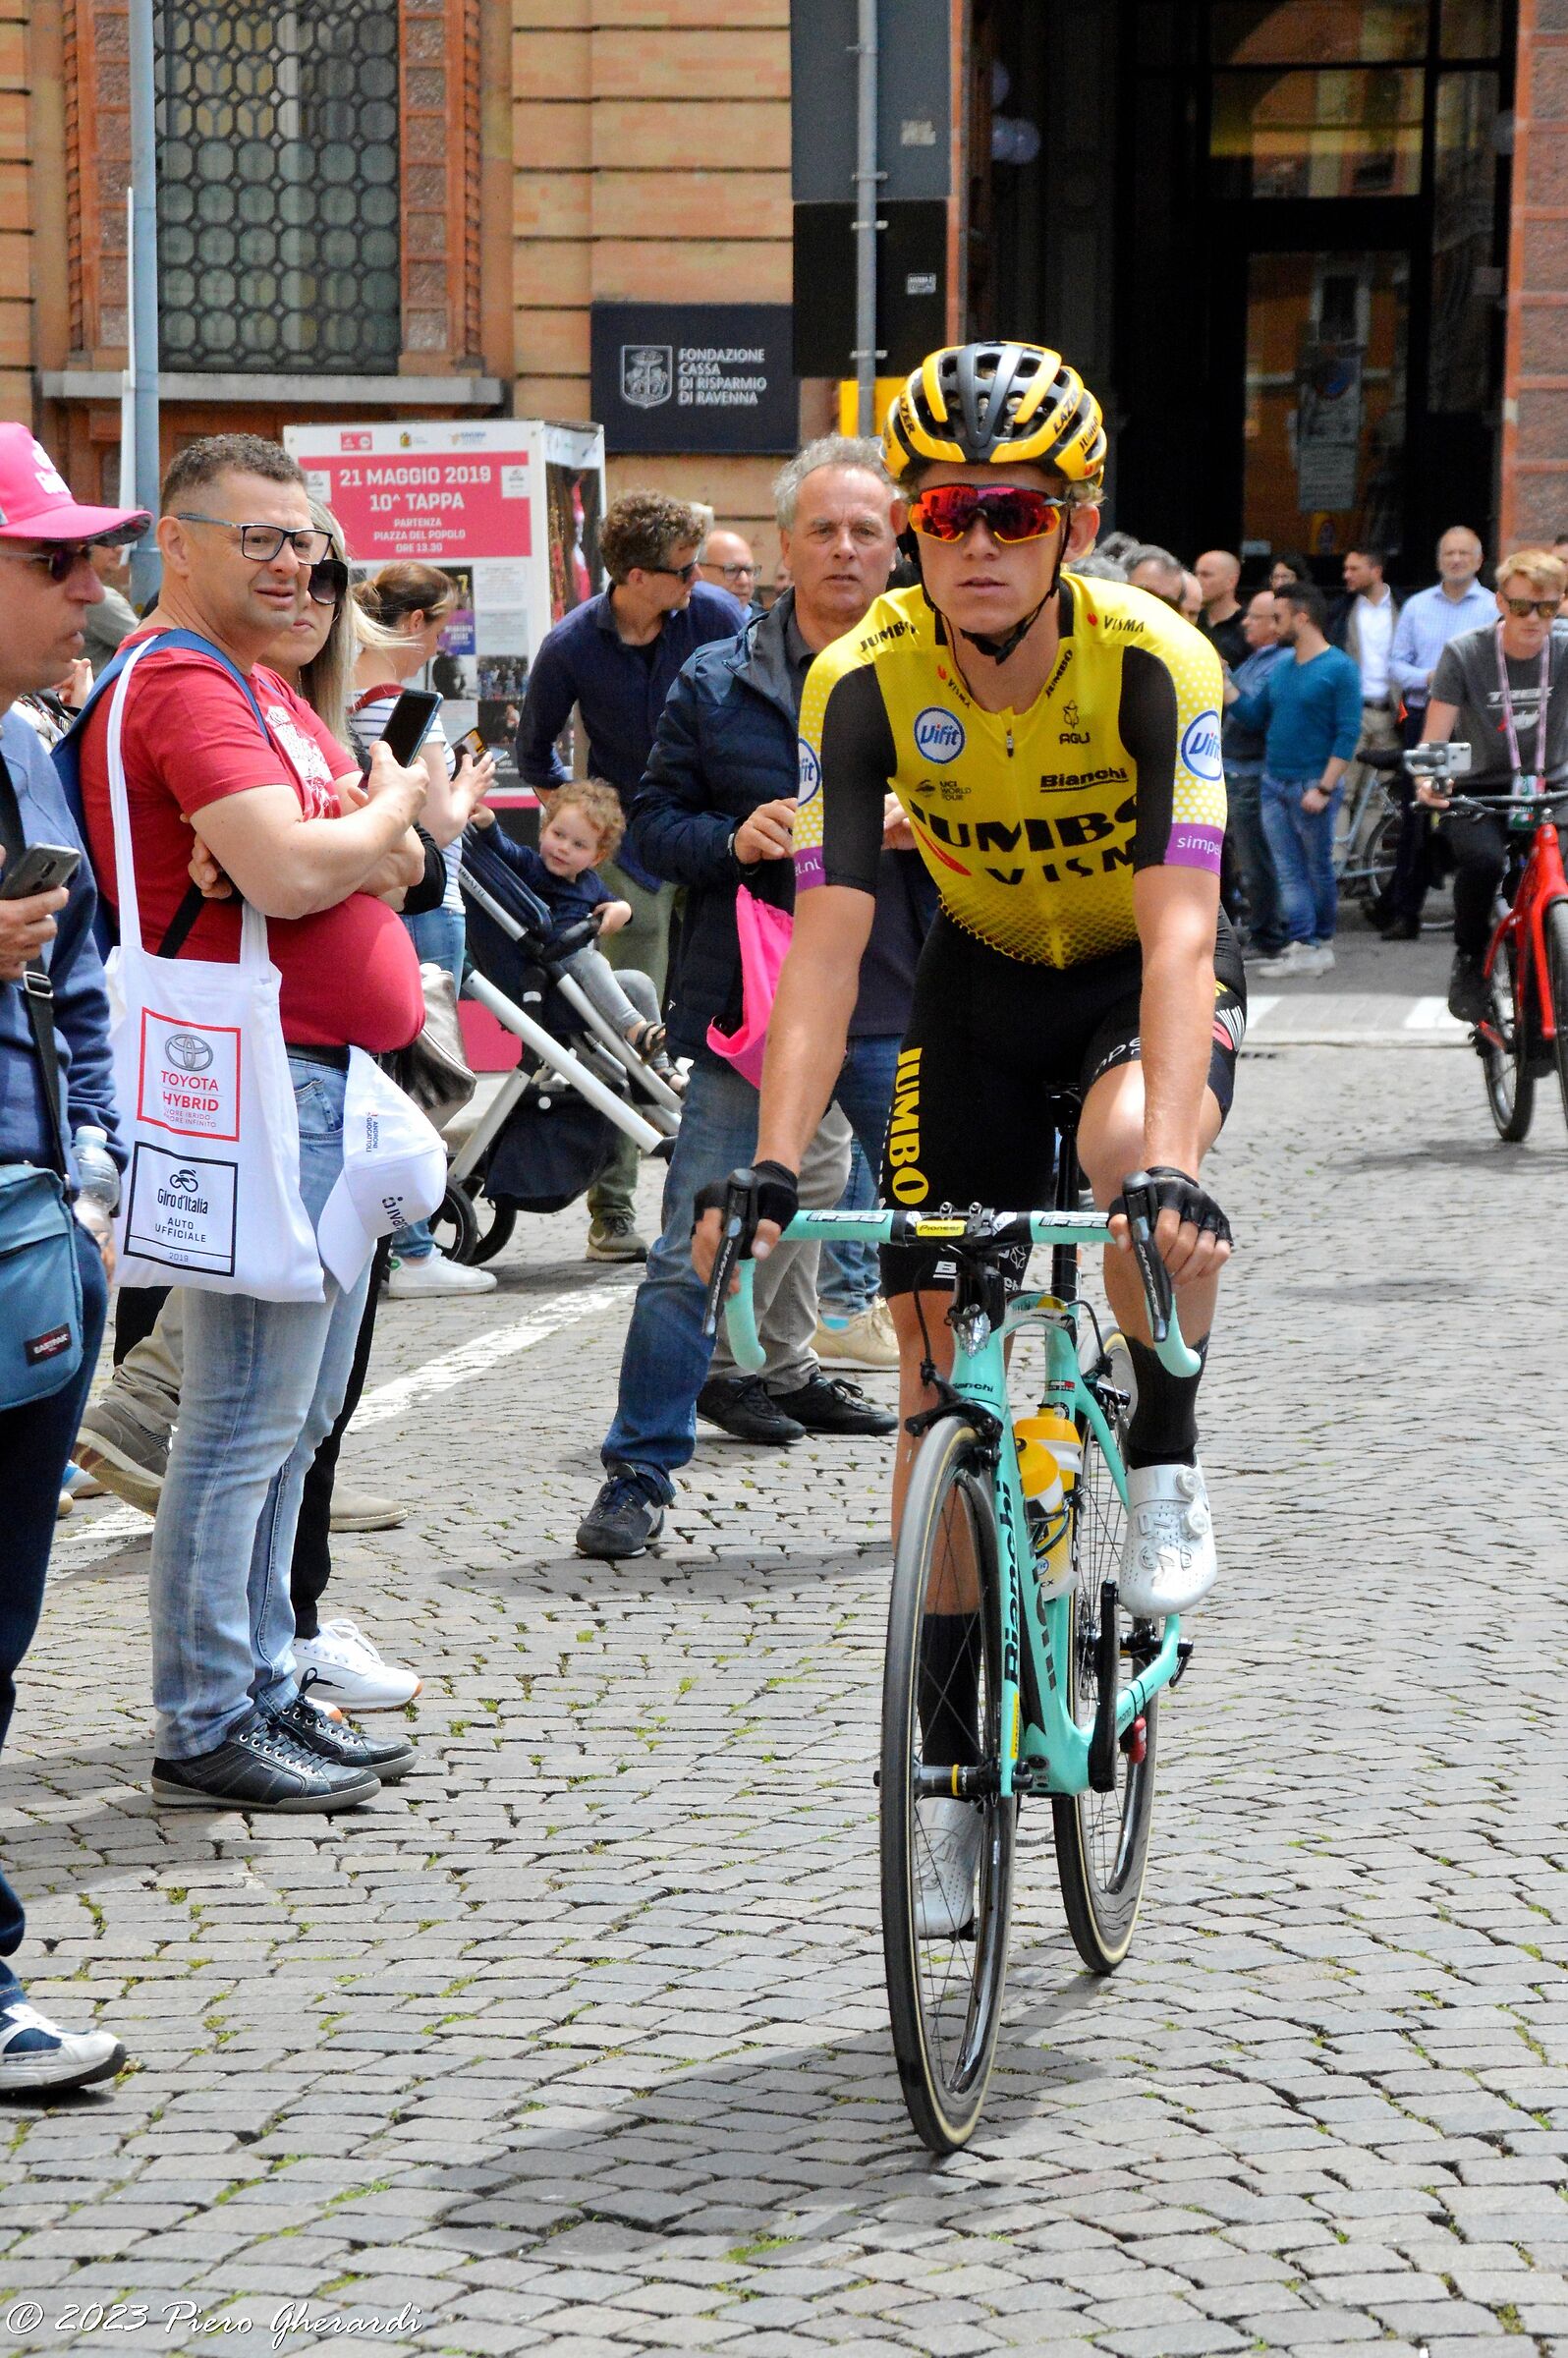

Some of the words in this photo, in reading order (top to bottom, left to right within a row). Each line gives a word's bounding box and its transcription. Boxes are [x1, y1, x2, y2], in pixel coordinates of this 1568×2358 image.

[679, 348, 765, 363] FONDAZIONE
[679, 363, 721, 376] CASSA
[679, 377, 694, 390] DI
[696, 376, 767, 390] RISPARMIO
[679, 392, 694, 405] DI
[696, 392, 758, 405] RAVENNA
[339, 470, 362, 487] 21
[366, 467, 440, 486] MAGGIO
[444, 466, 491, 484] 2019
[406, 492, 465, 511] TAPPA
[394, 518, 442, 527] PARTENZA
[373, 532, 407, 540] PIAZZA
[409, 531, 426, 539] DEL
[428, 530, 466, 539] POPOLO
[396, 543, 414, 553] ORE
[1104, 615, 1145, 633] VISMA
[861, 620, 917, 652] JUMBO
[1045, 649, 1073, 699] JUMBO
[947, 678, 971, 708] VISMA
[1059, 731, 1091, 745] AGU
[1040, 767, 1128, 788] Bianchi
[984, 835, 1137, 885] VISM
[161, 1070, 219, 1092] TOYOTA
[163, 1091, 220, 1112] HYBRID
[185, 1111, 211, 1121] IBRIDO
[185, 1118, 217, 1129] INFINITO
[157, 1188, 177, 1208] Giro
[167, 1217, 195, 1230] AUTO
[154, 1223, 206, 1243] UFFICIALE
[169, 1252, 190, 1263] 2019
[952, 1382, 994, 1393] ianchi
